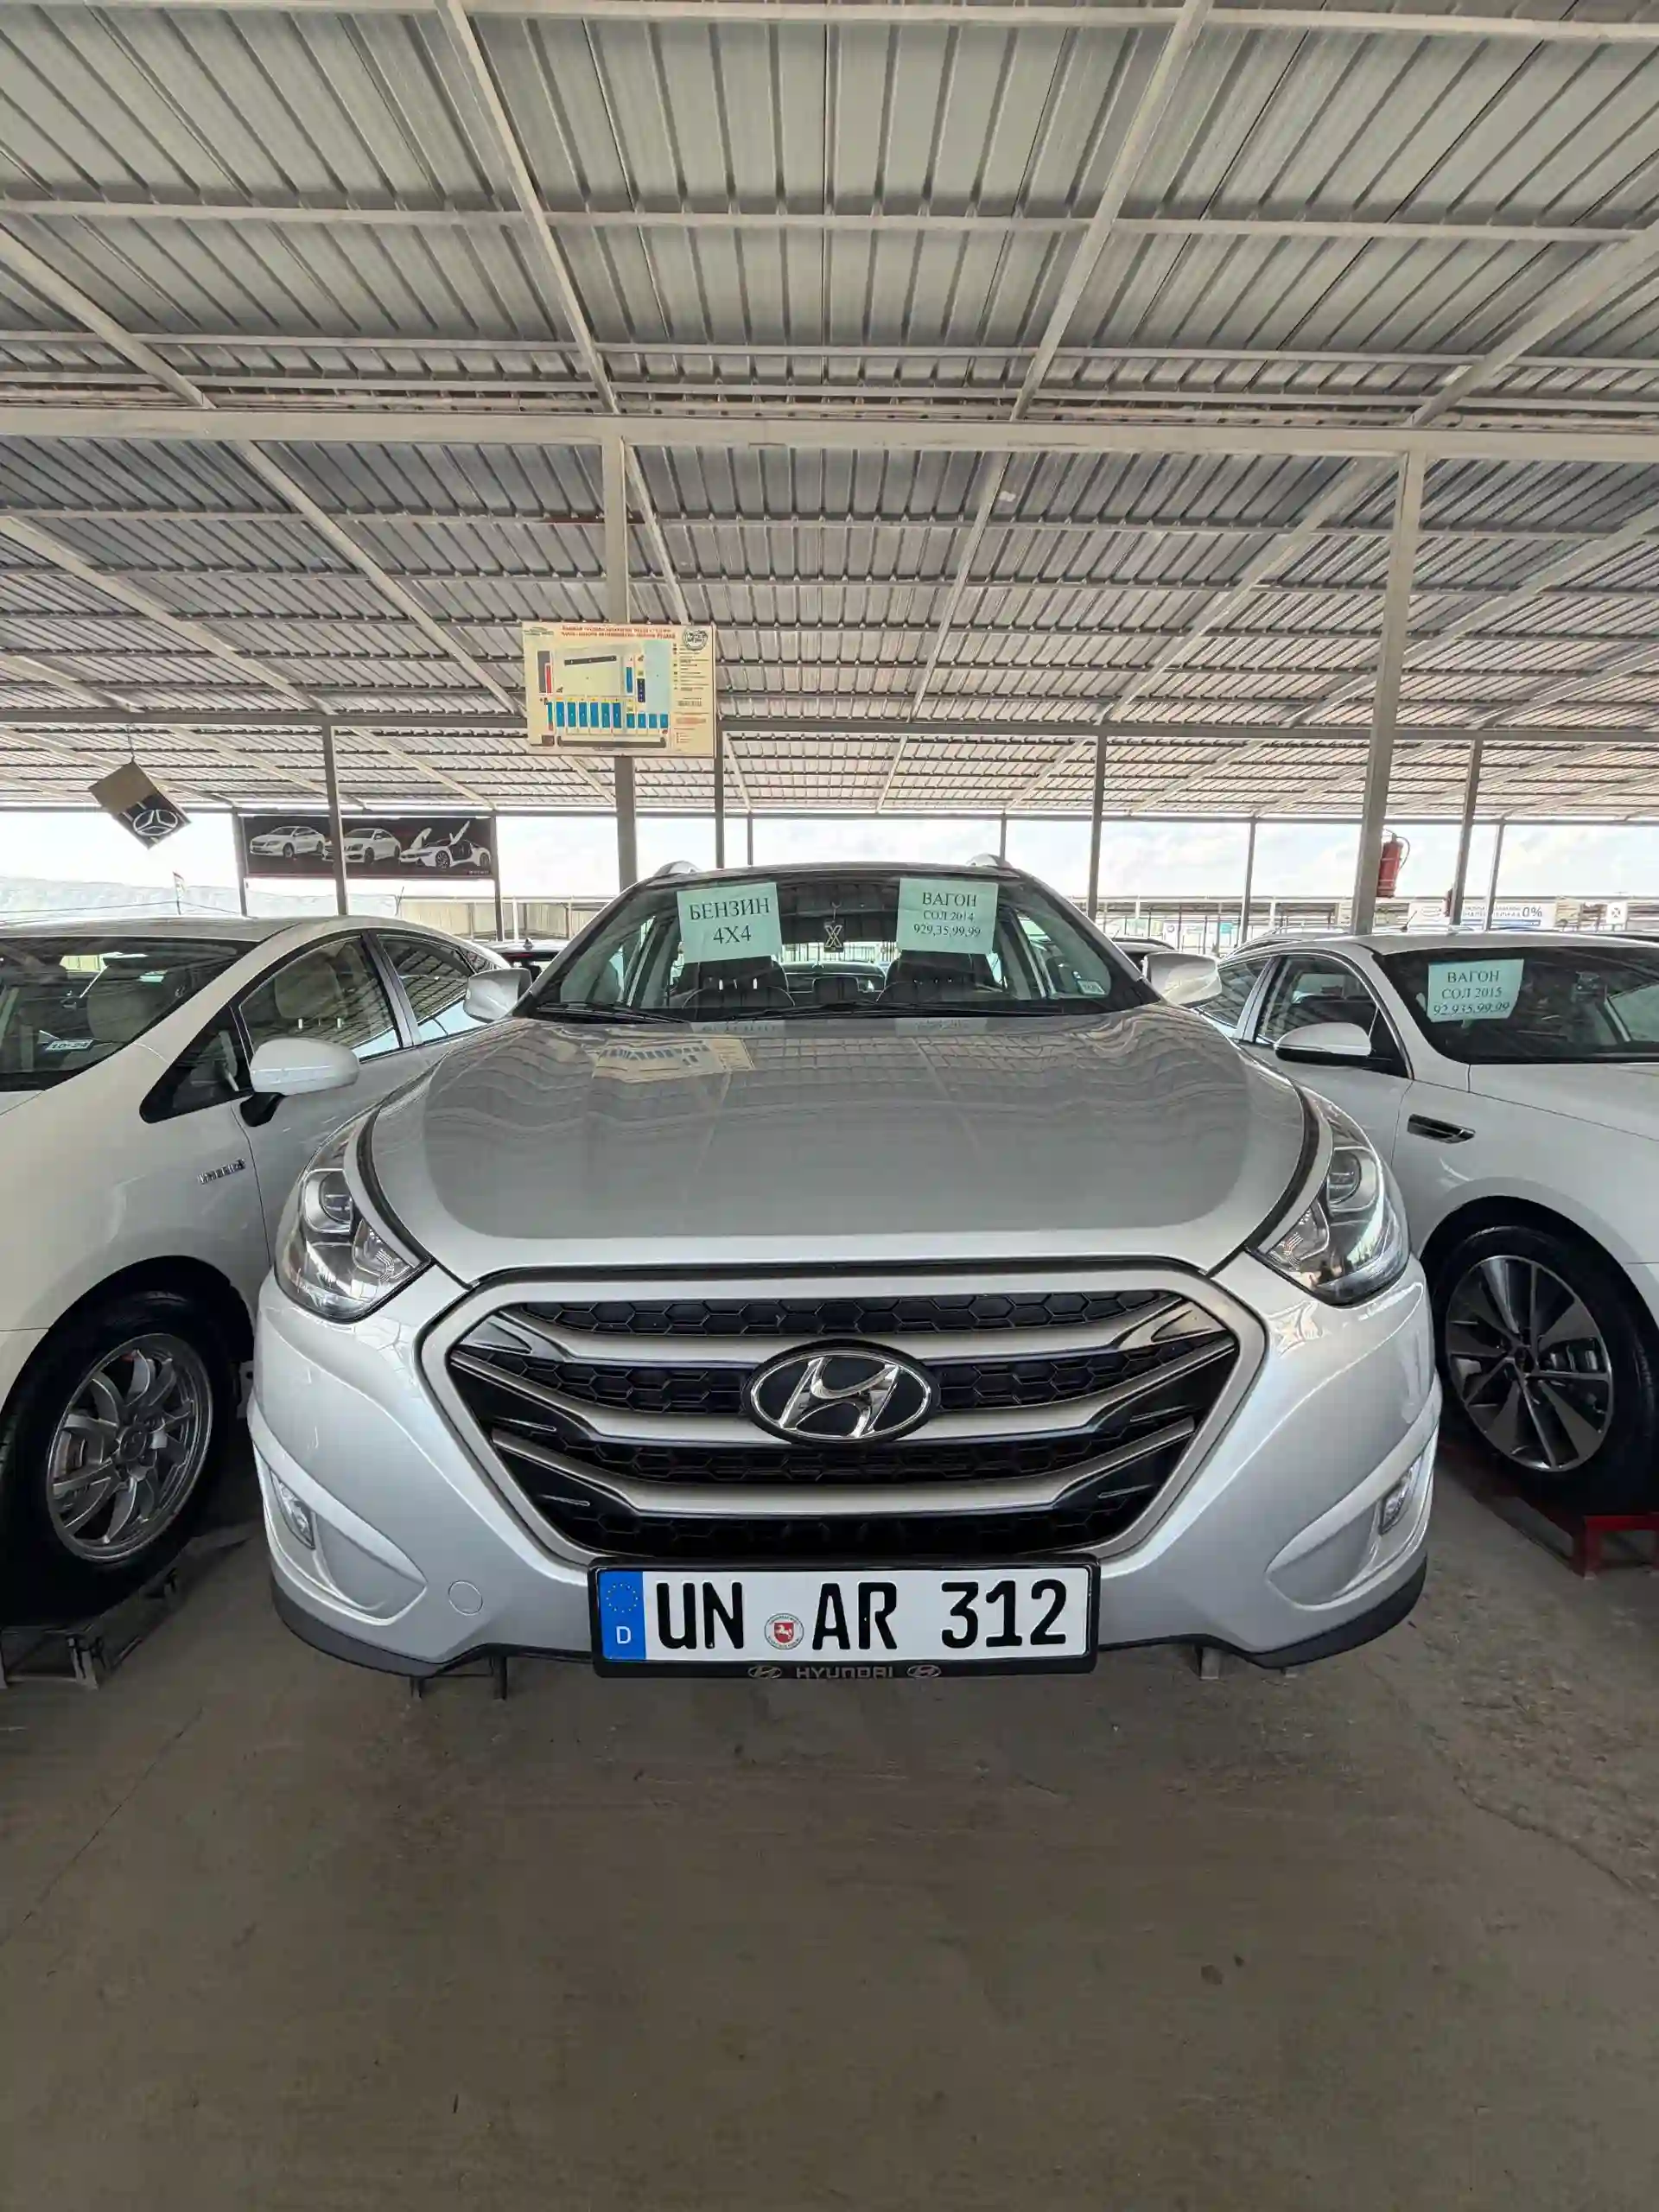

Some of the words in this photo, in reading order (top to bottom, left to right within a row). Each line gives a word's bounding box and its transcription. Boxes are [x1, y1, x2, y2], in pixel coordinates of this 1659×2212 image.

[922, 892, 977, 907] ВАГОН
[690, 897, 769, 920] БЕНЗИН
[923, 909, 947, 921] СОЛ
[950, 912, 975, 922] 2014
[1447, 970, 1499, 983] ВАГОН
[1441, 988, 1470, 999] СОЛ
[1474, 987, 1503, 998] 2015
[656, 1582, 745, 1650] UN
[812, 1582, 899, 1650] AR
[941, 1580, 1068, 1649] 312
[616, 1626, 632, 1644] D
[796, 1666, 893, 1679] HYUNDAI
